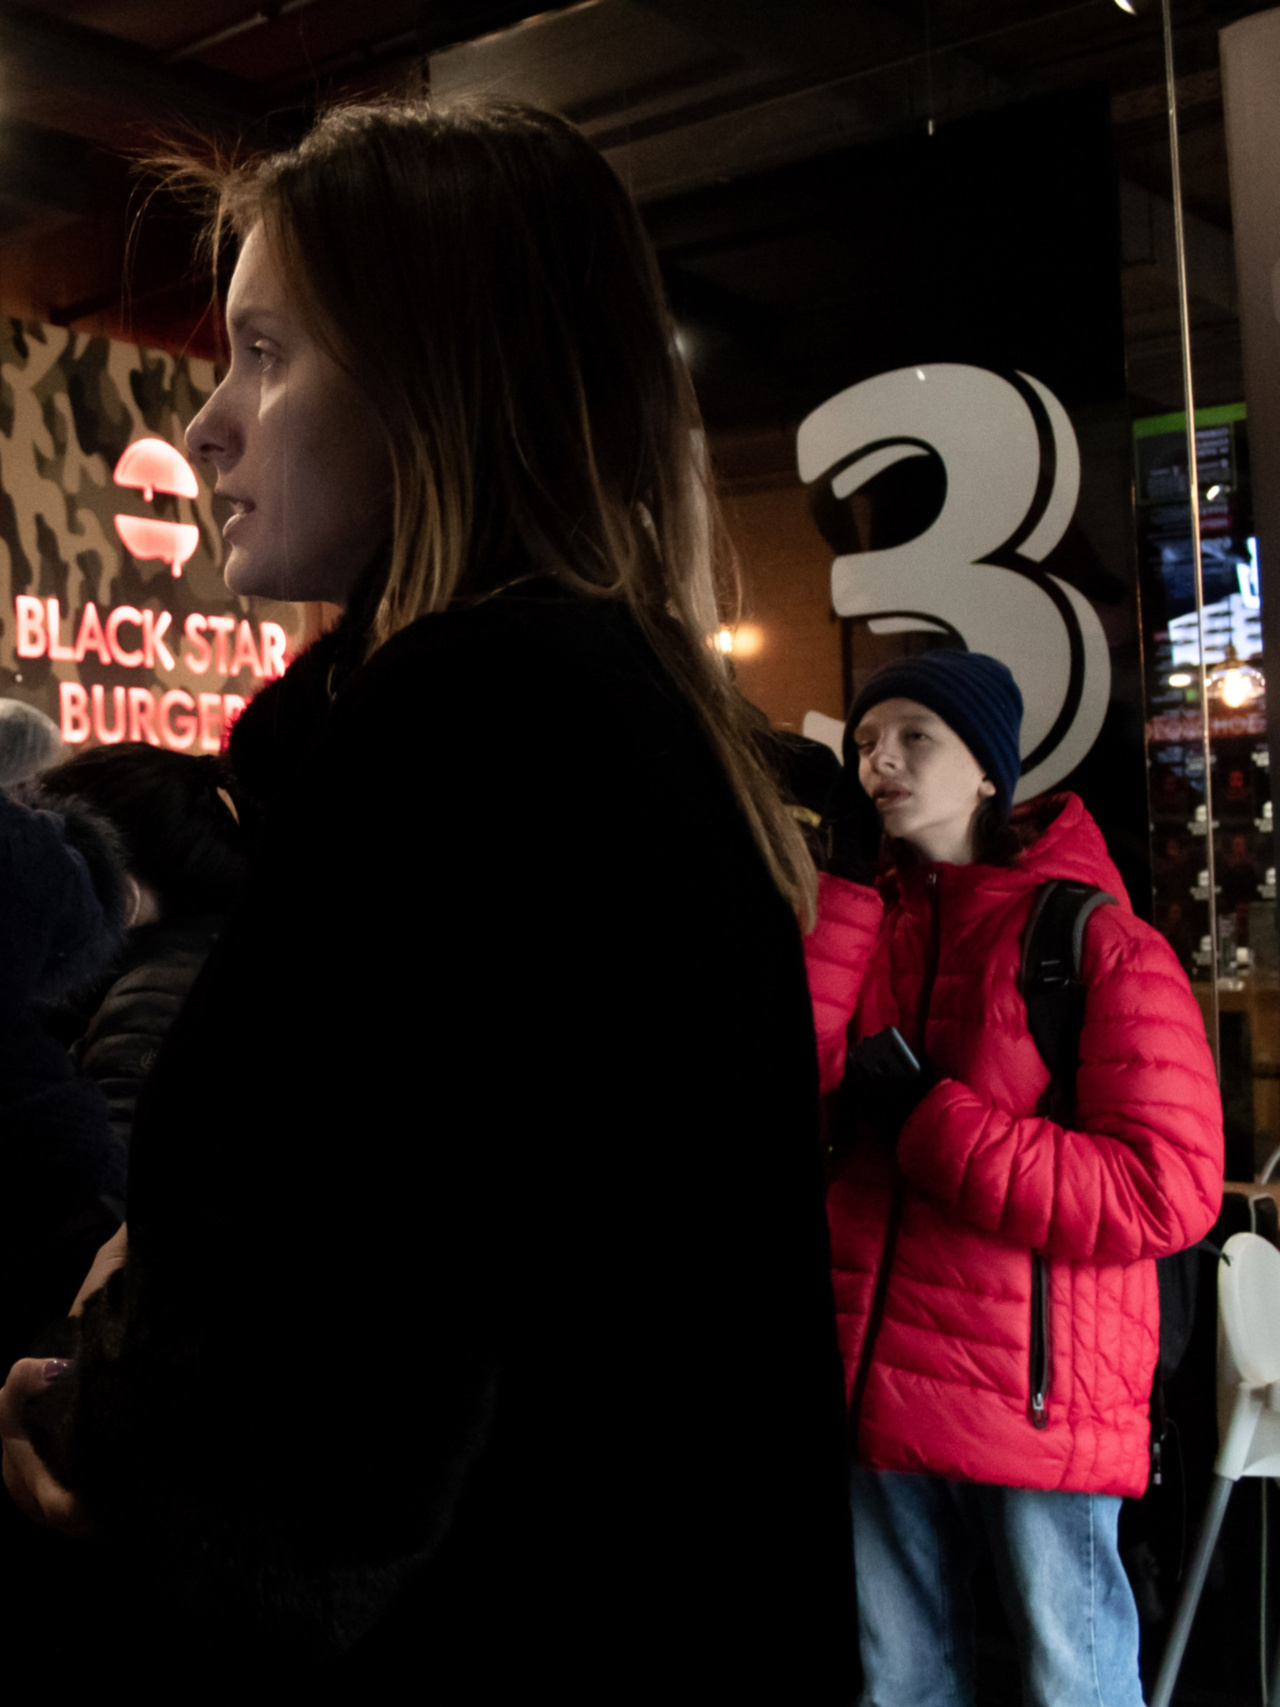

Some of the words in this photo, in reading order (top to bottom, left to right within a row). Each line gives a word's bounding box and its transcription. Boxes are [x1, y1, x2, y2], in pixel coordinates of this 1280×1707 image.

[14, 594, 176, 672] BLACK
[183, 611, 288, 678] STAR
[795, 361, 1112, 808] 3
